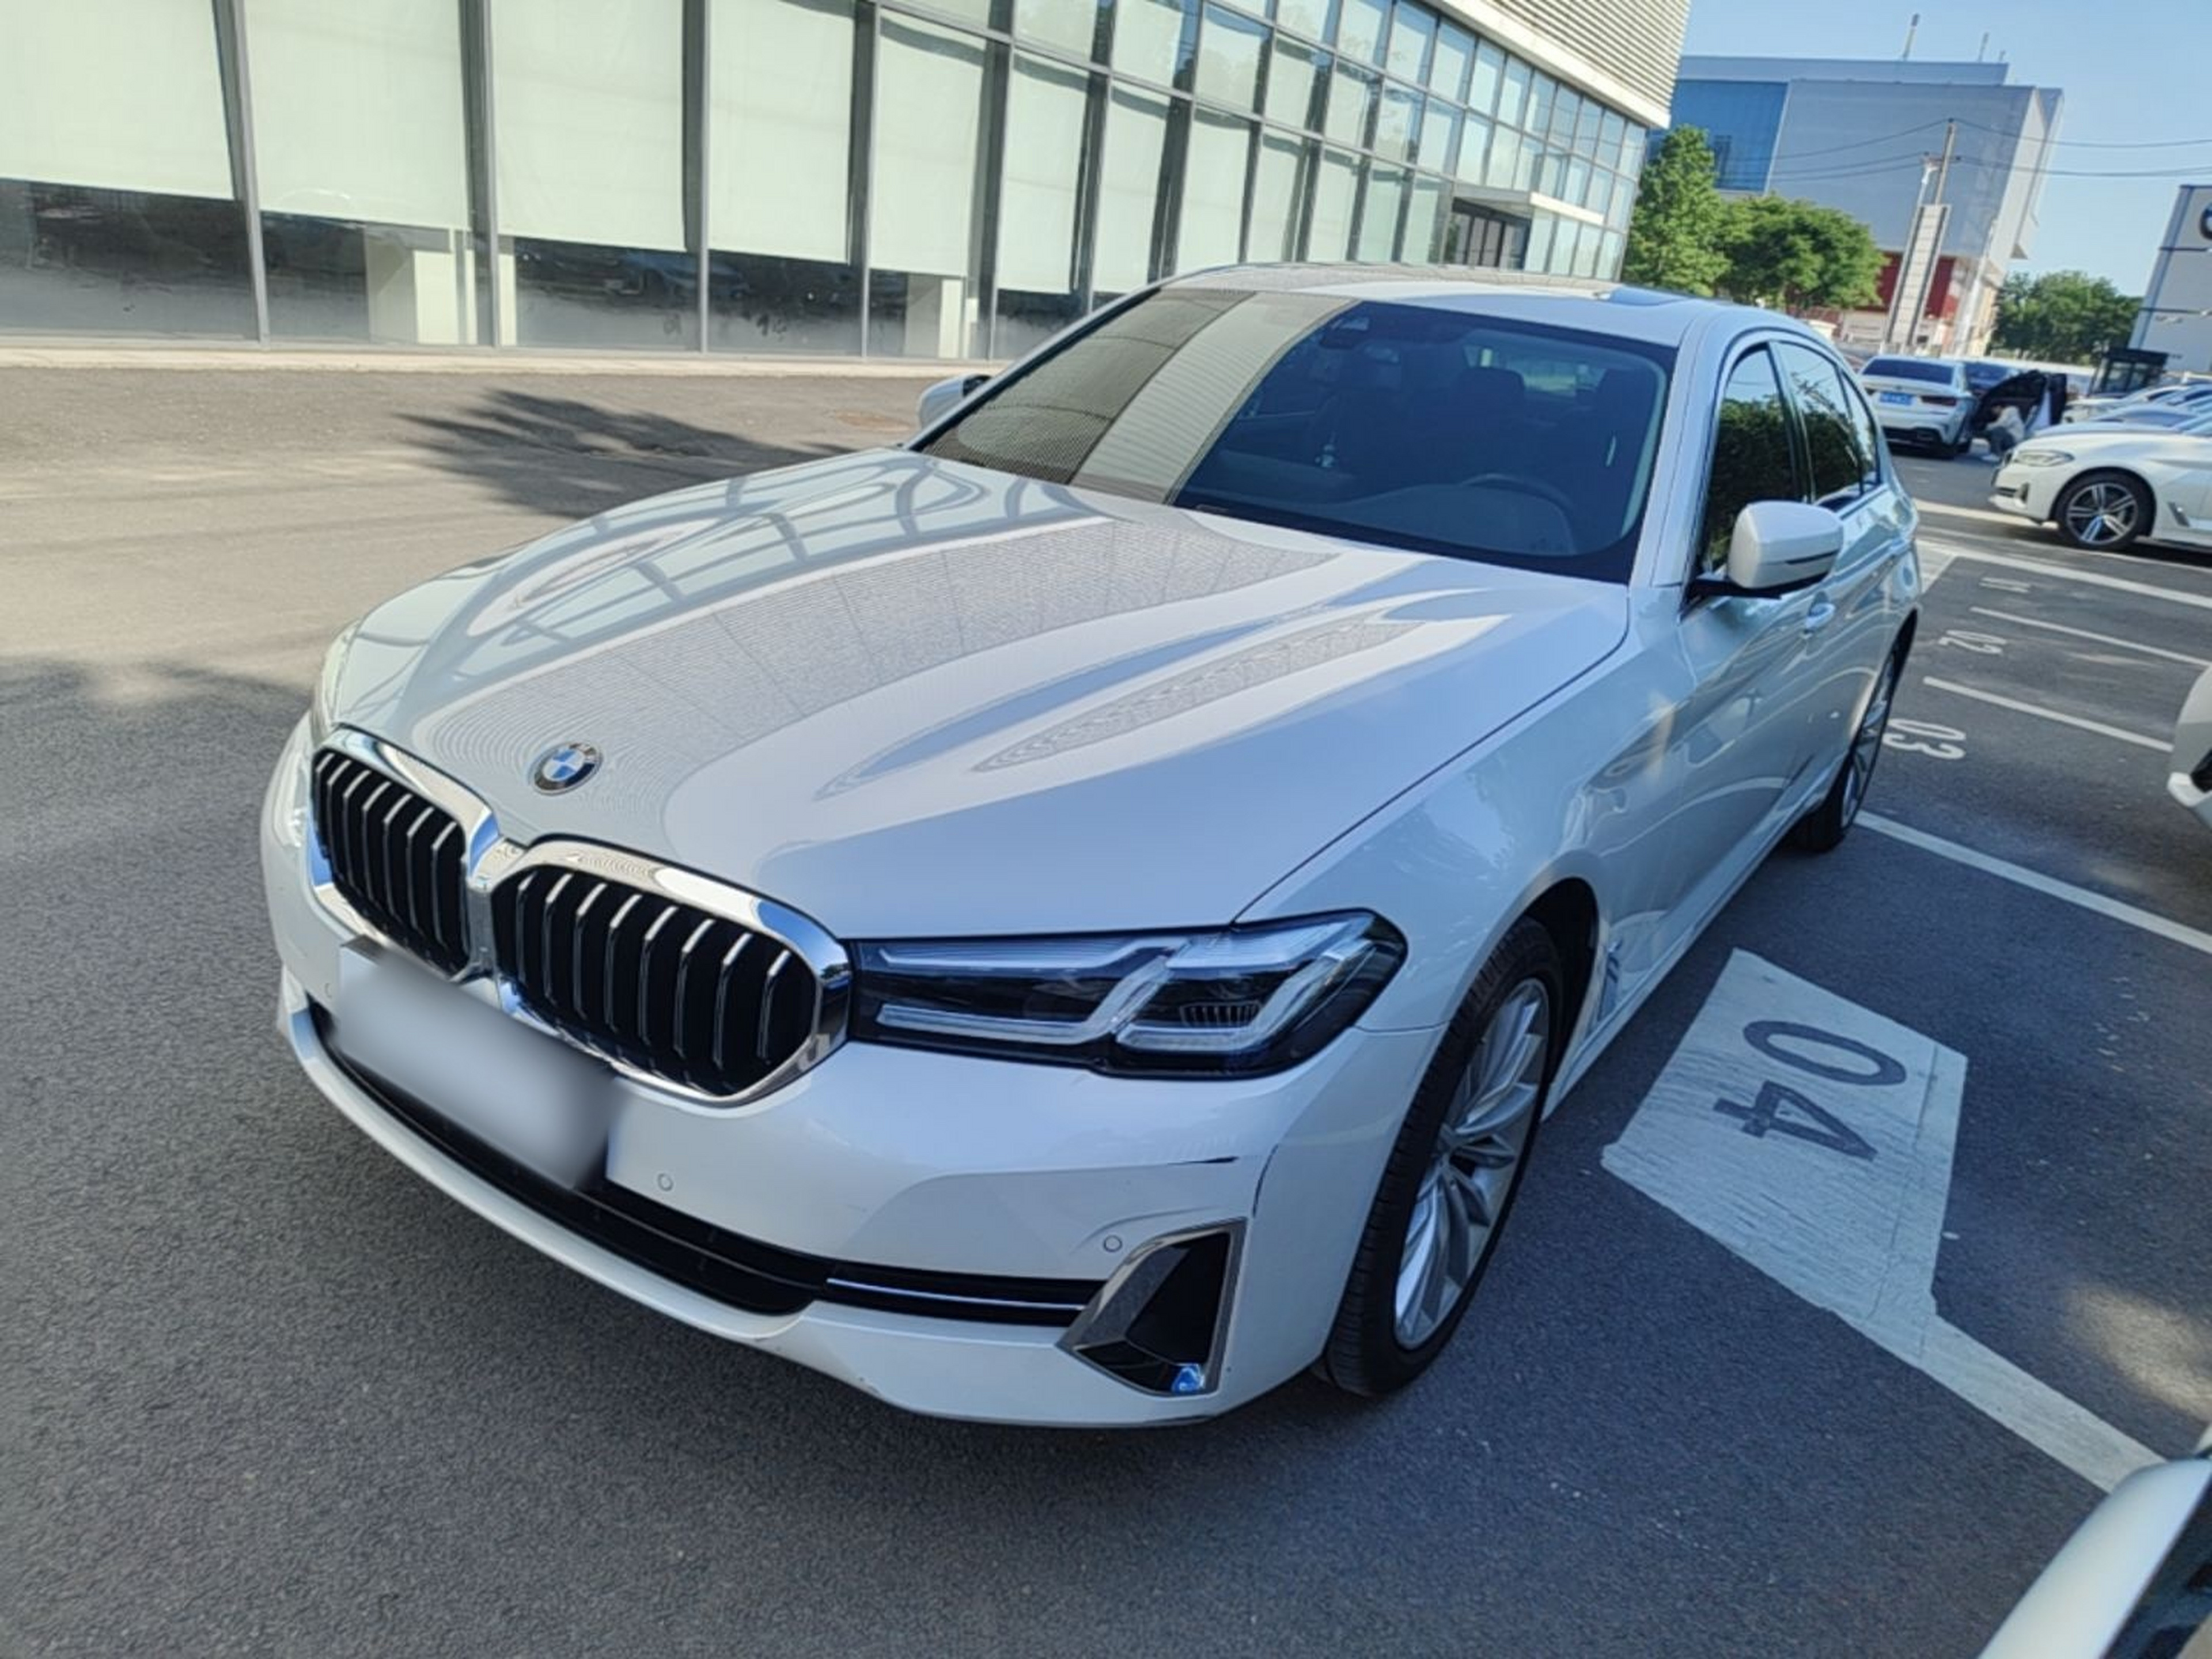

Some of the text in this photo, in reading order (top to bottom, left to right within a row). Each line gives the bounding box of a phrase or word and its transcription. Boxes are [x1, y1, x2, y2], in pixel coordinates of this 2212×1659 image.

[1938, 630, 2006, 654] 02
[1883, 718, 1965, 759] 03
[1713, 1020, 1906, 1161] 04
